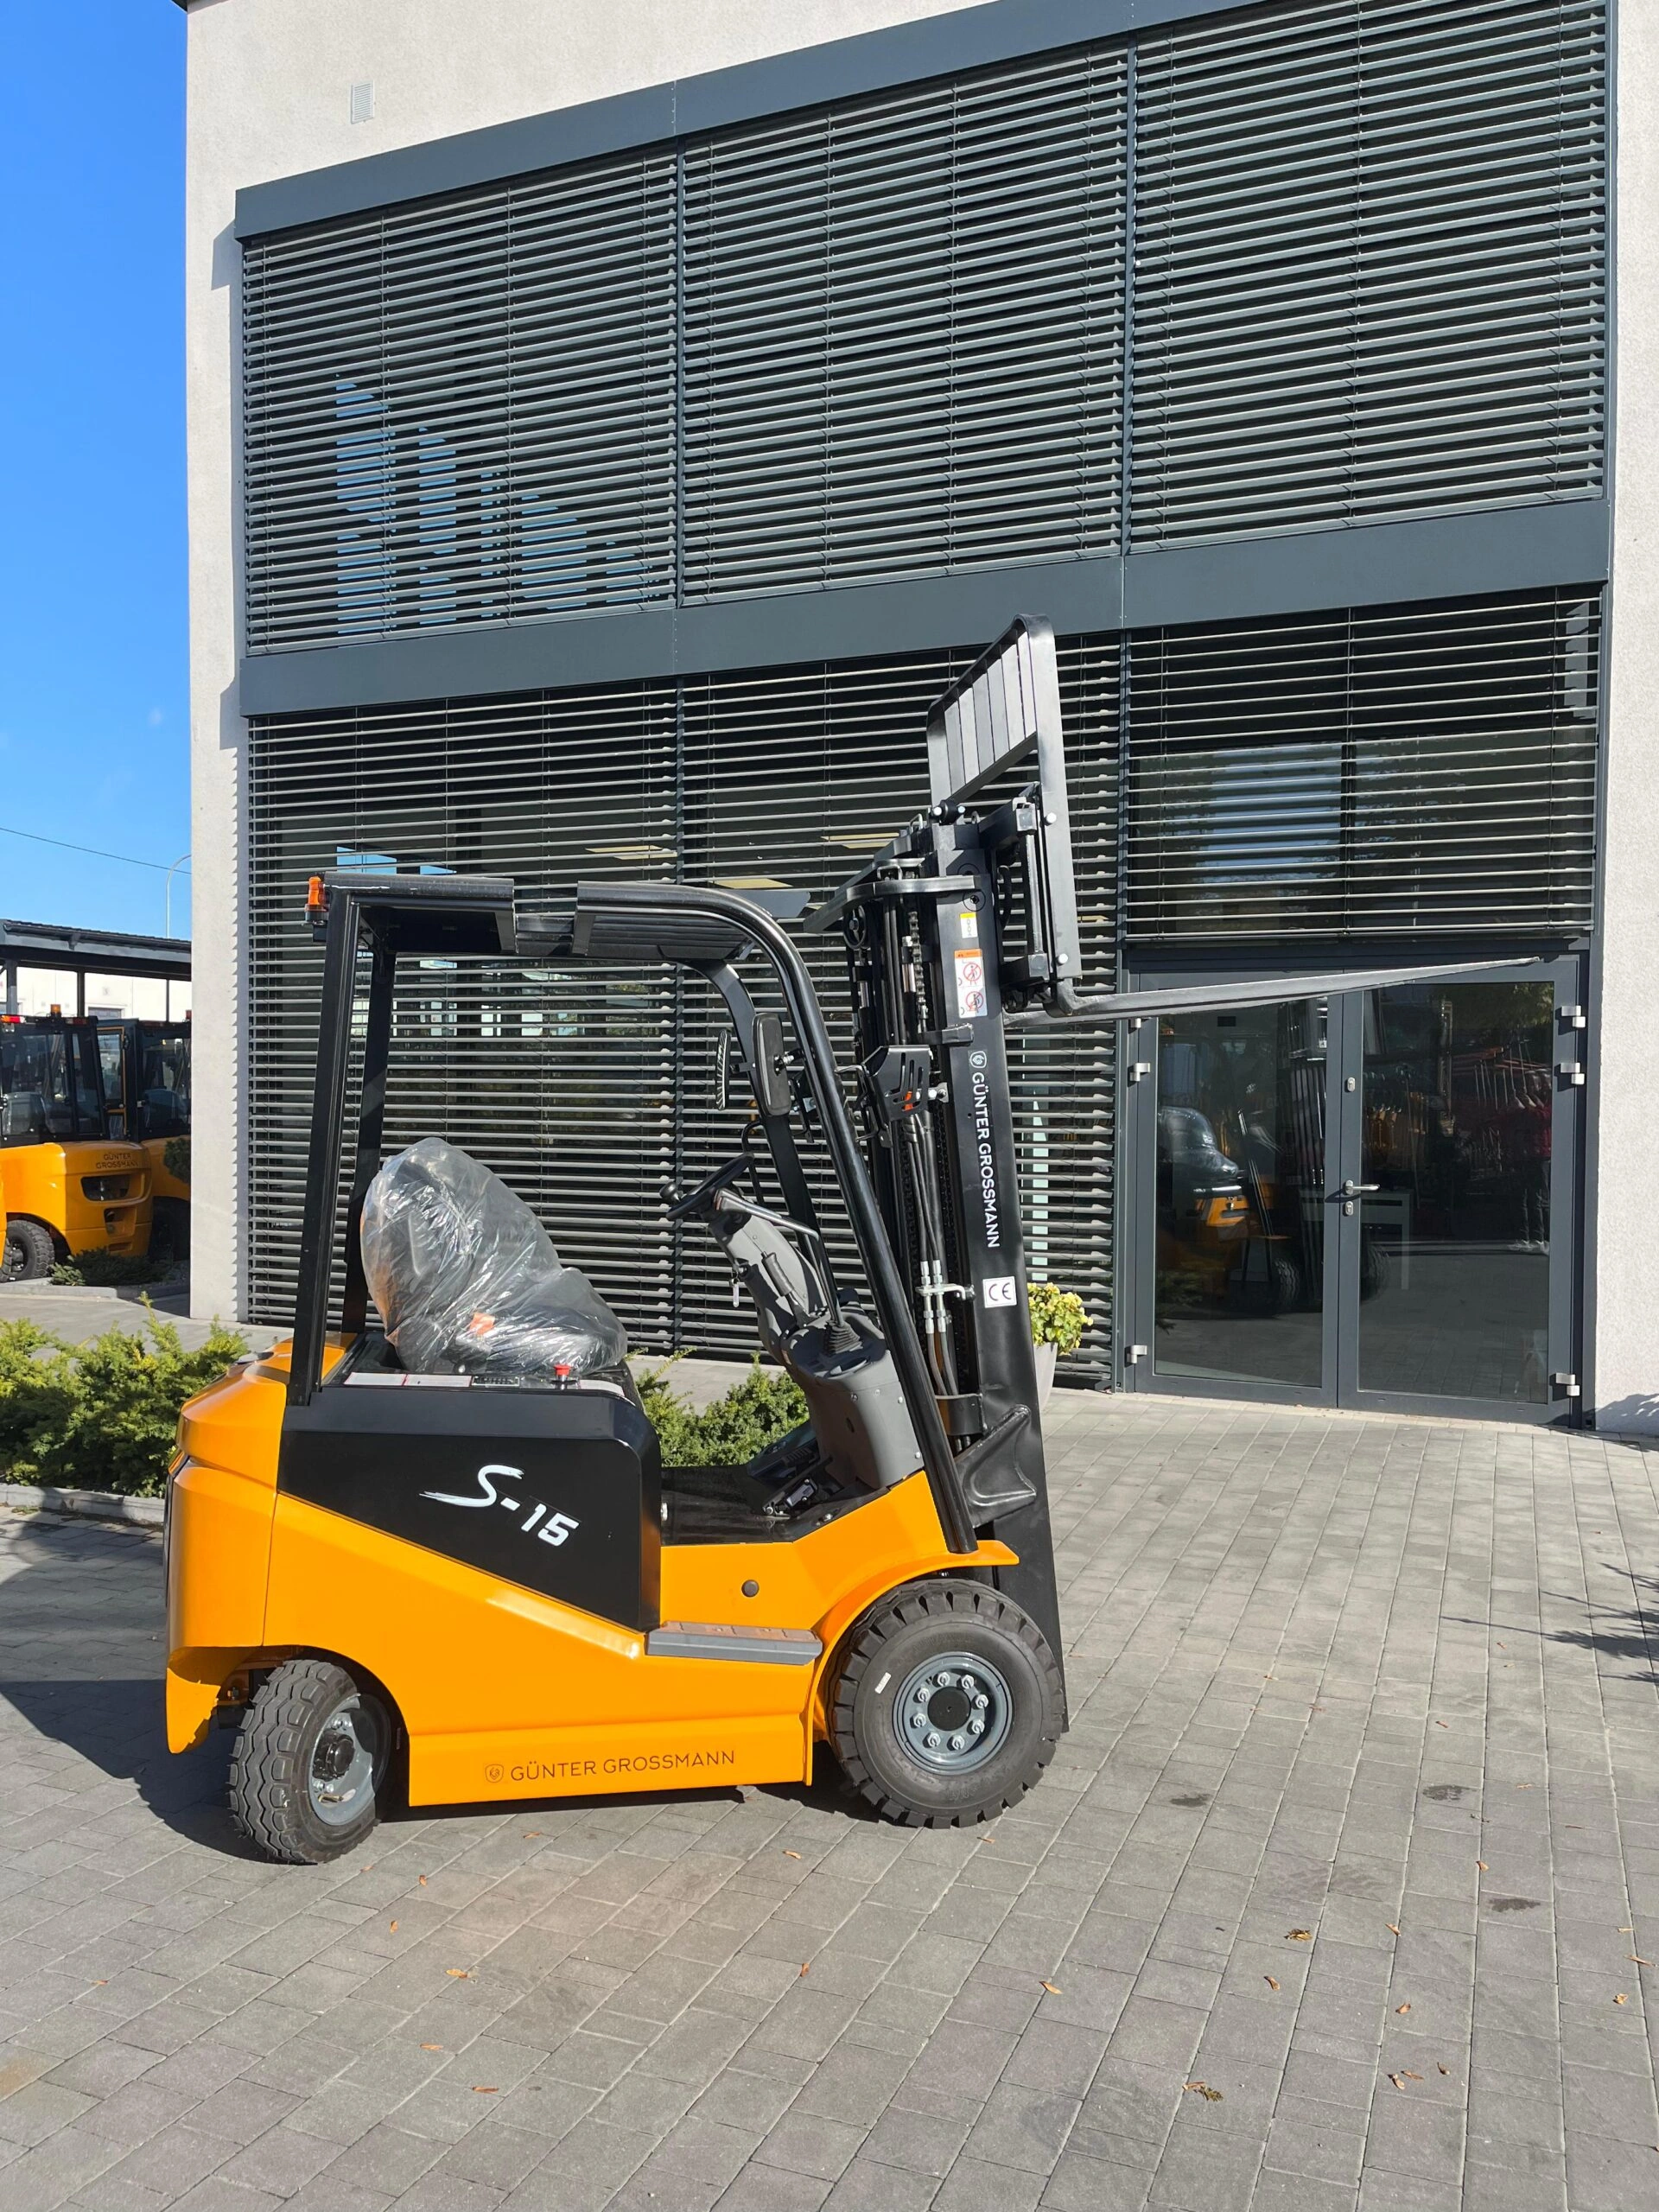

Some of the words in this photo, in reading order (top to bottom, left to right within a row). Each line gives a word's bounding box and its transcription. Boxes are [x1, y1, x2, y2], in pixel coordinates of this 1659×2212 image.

[972, 1071, 989, 1140] GÜNTER
[978, 1142, 1001, 1248] GROSSMANN
[988, 1282, 1012, 1301] CE
[419, 1464, 580, 1547] S-15
[510, 1761, 597, 1782] GÜNTER
[603, 1750, 735, 1774] GROSSMANN
